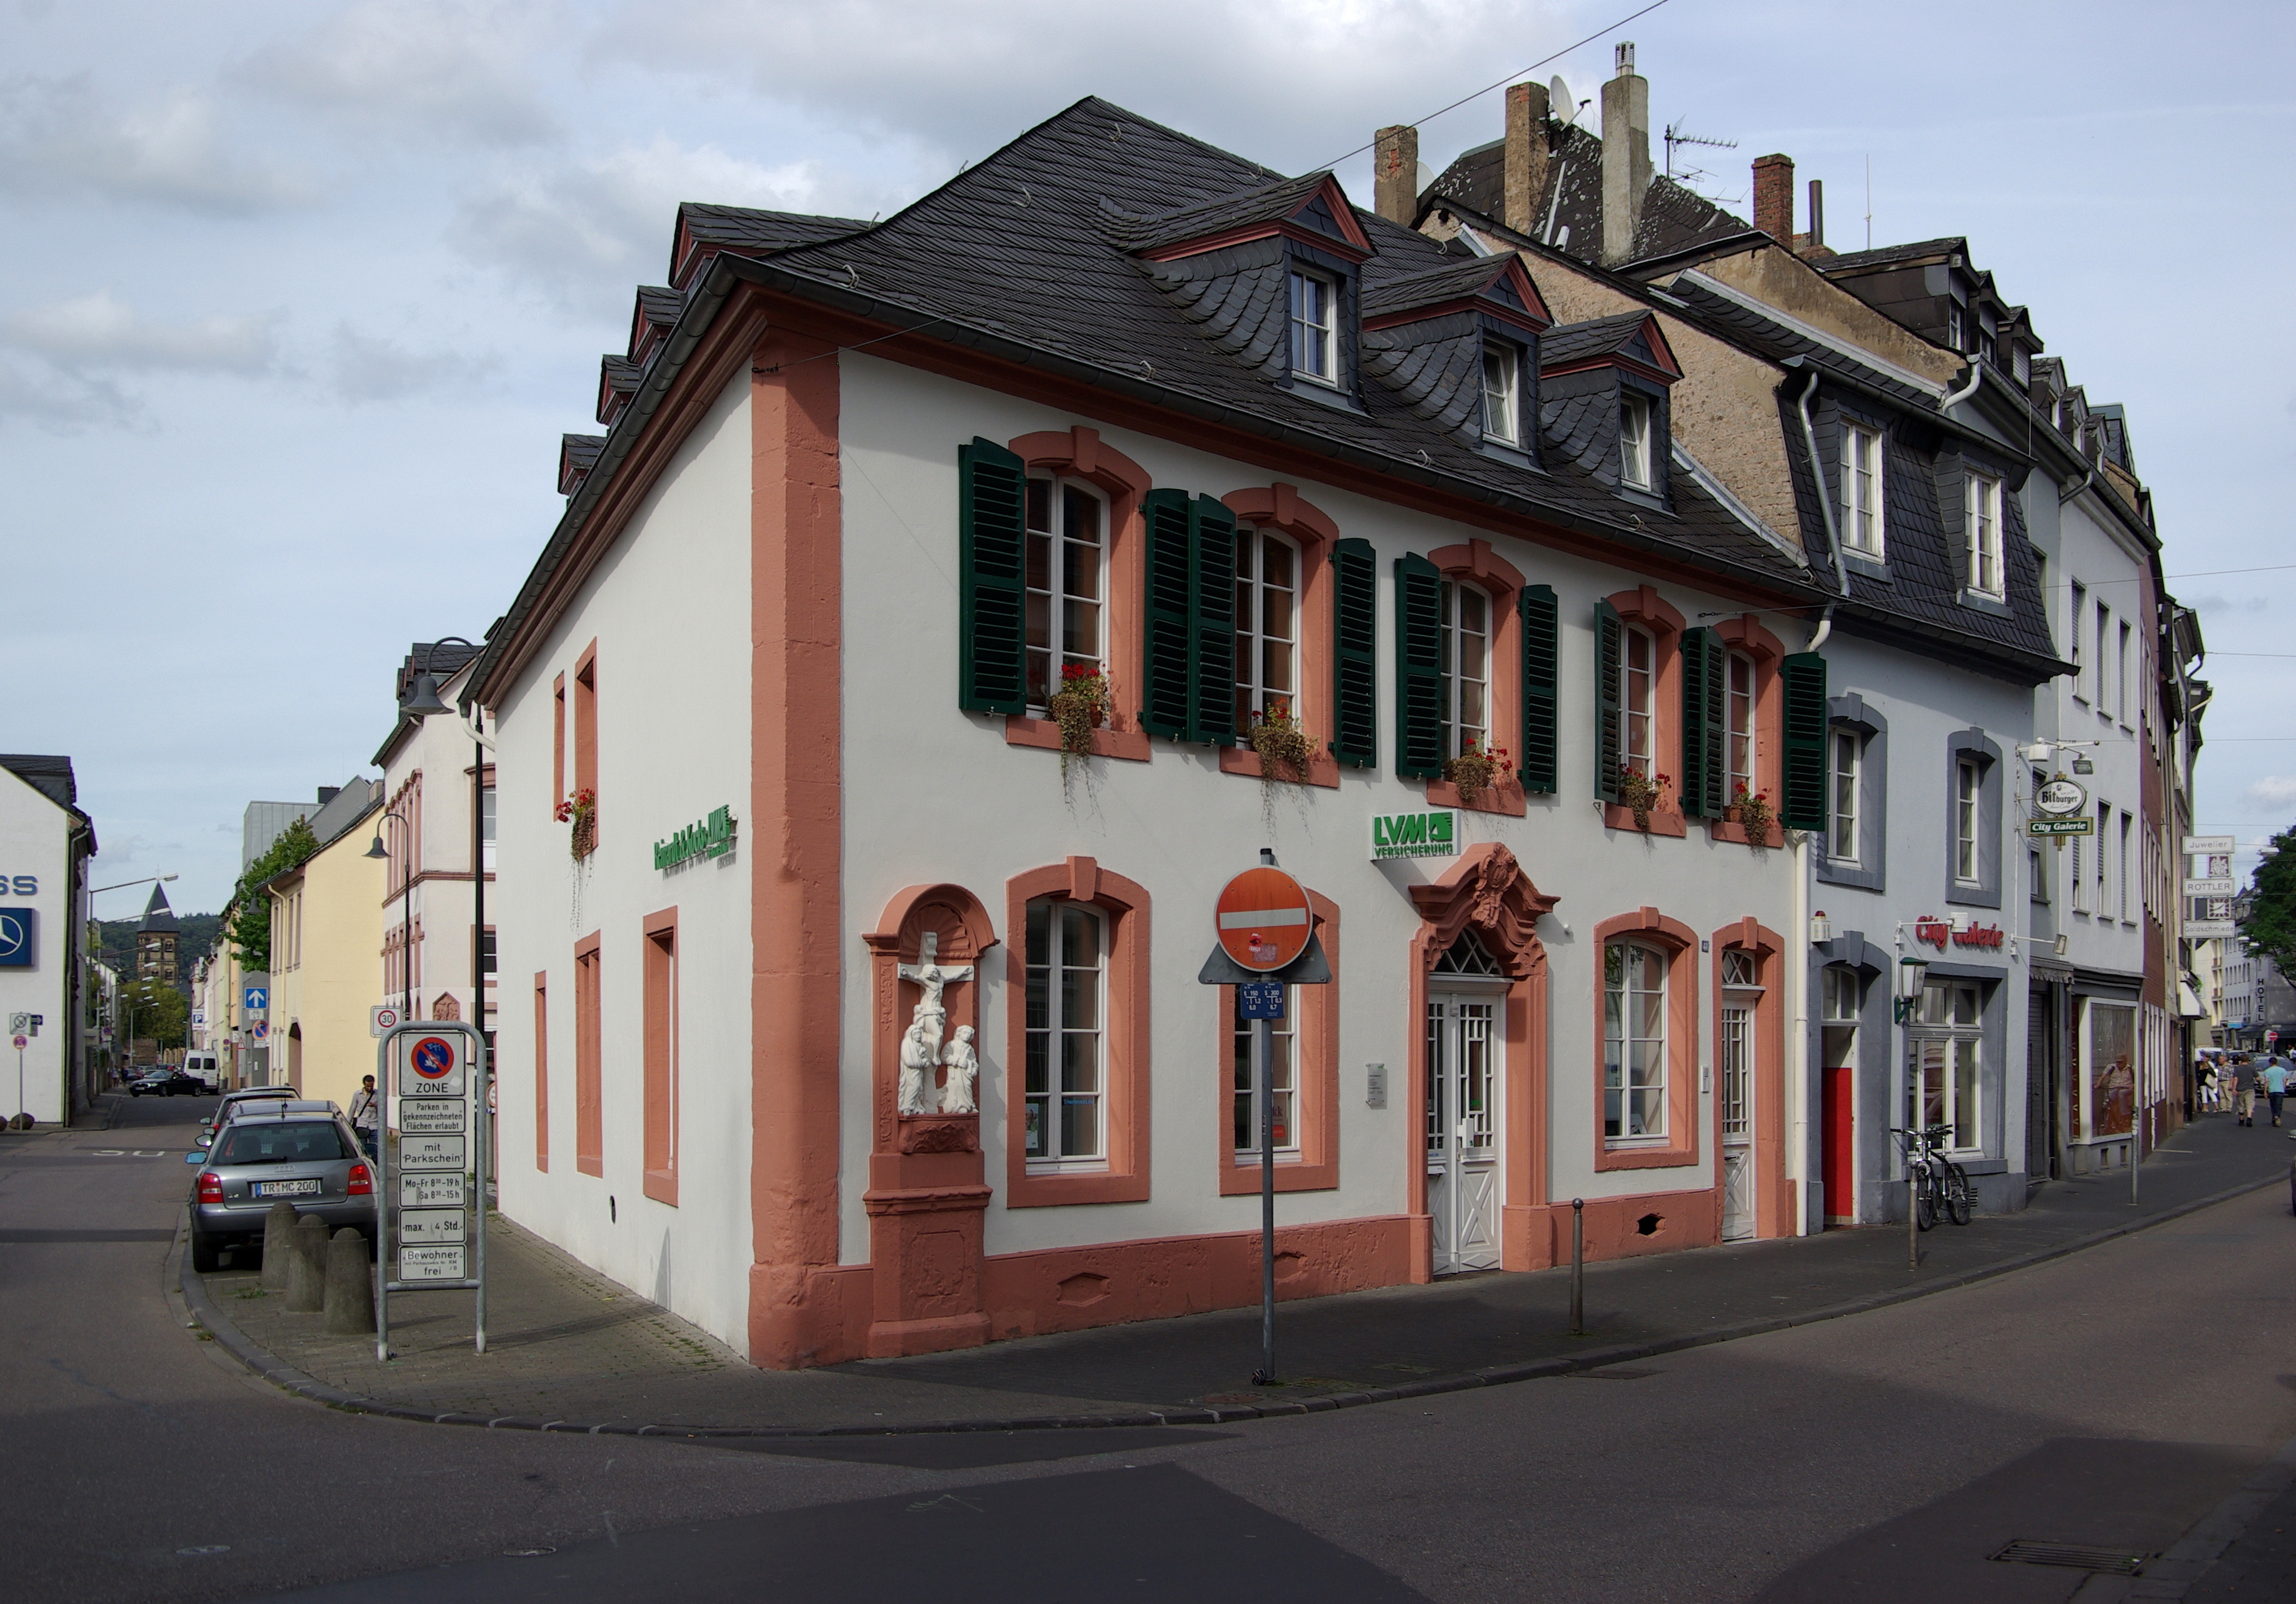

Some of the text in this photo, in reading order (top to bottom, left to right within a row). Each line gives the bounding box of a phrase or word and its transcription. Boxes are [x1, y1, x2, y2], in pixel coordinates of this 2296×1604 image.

[2041, 791, 2078, 804] Bitburger
[1375, 814, 1426, 845] LVM
[2032, 822, 2086, 832] City Galerie
[1374, 843, 1453, 858] VERSICHERUNG
[2188, 883, 2230, 891] ROTTLER
[1915, 915, 1948, 948] City
[2184, 925, 2234, 933] Goldschmiede
[381, 1015, 393, 1023] 30
[416, 1083, 448, 1093] ZONE
[416, 1103, 449, 1111] Parken in
[403, 1113, 463, 1123] gekennzeichneten
[406, 1122, 459, 1130] Flächen erlaubt
[424, 1143, 441, 1151] mit
[404, 1153, 460, 1163] Parkschein
[263, 1181, 315, 1193] TR MC 200
[419, 1191, 428, 1200] Sa
[405, 1224, 425, 1232] max.
[444, 1221, 460, 1231] Std.
[408, 1250, 458, 1260] Bewohner
[424, 1266, 441, 1276] frei
